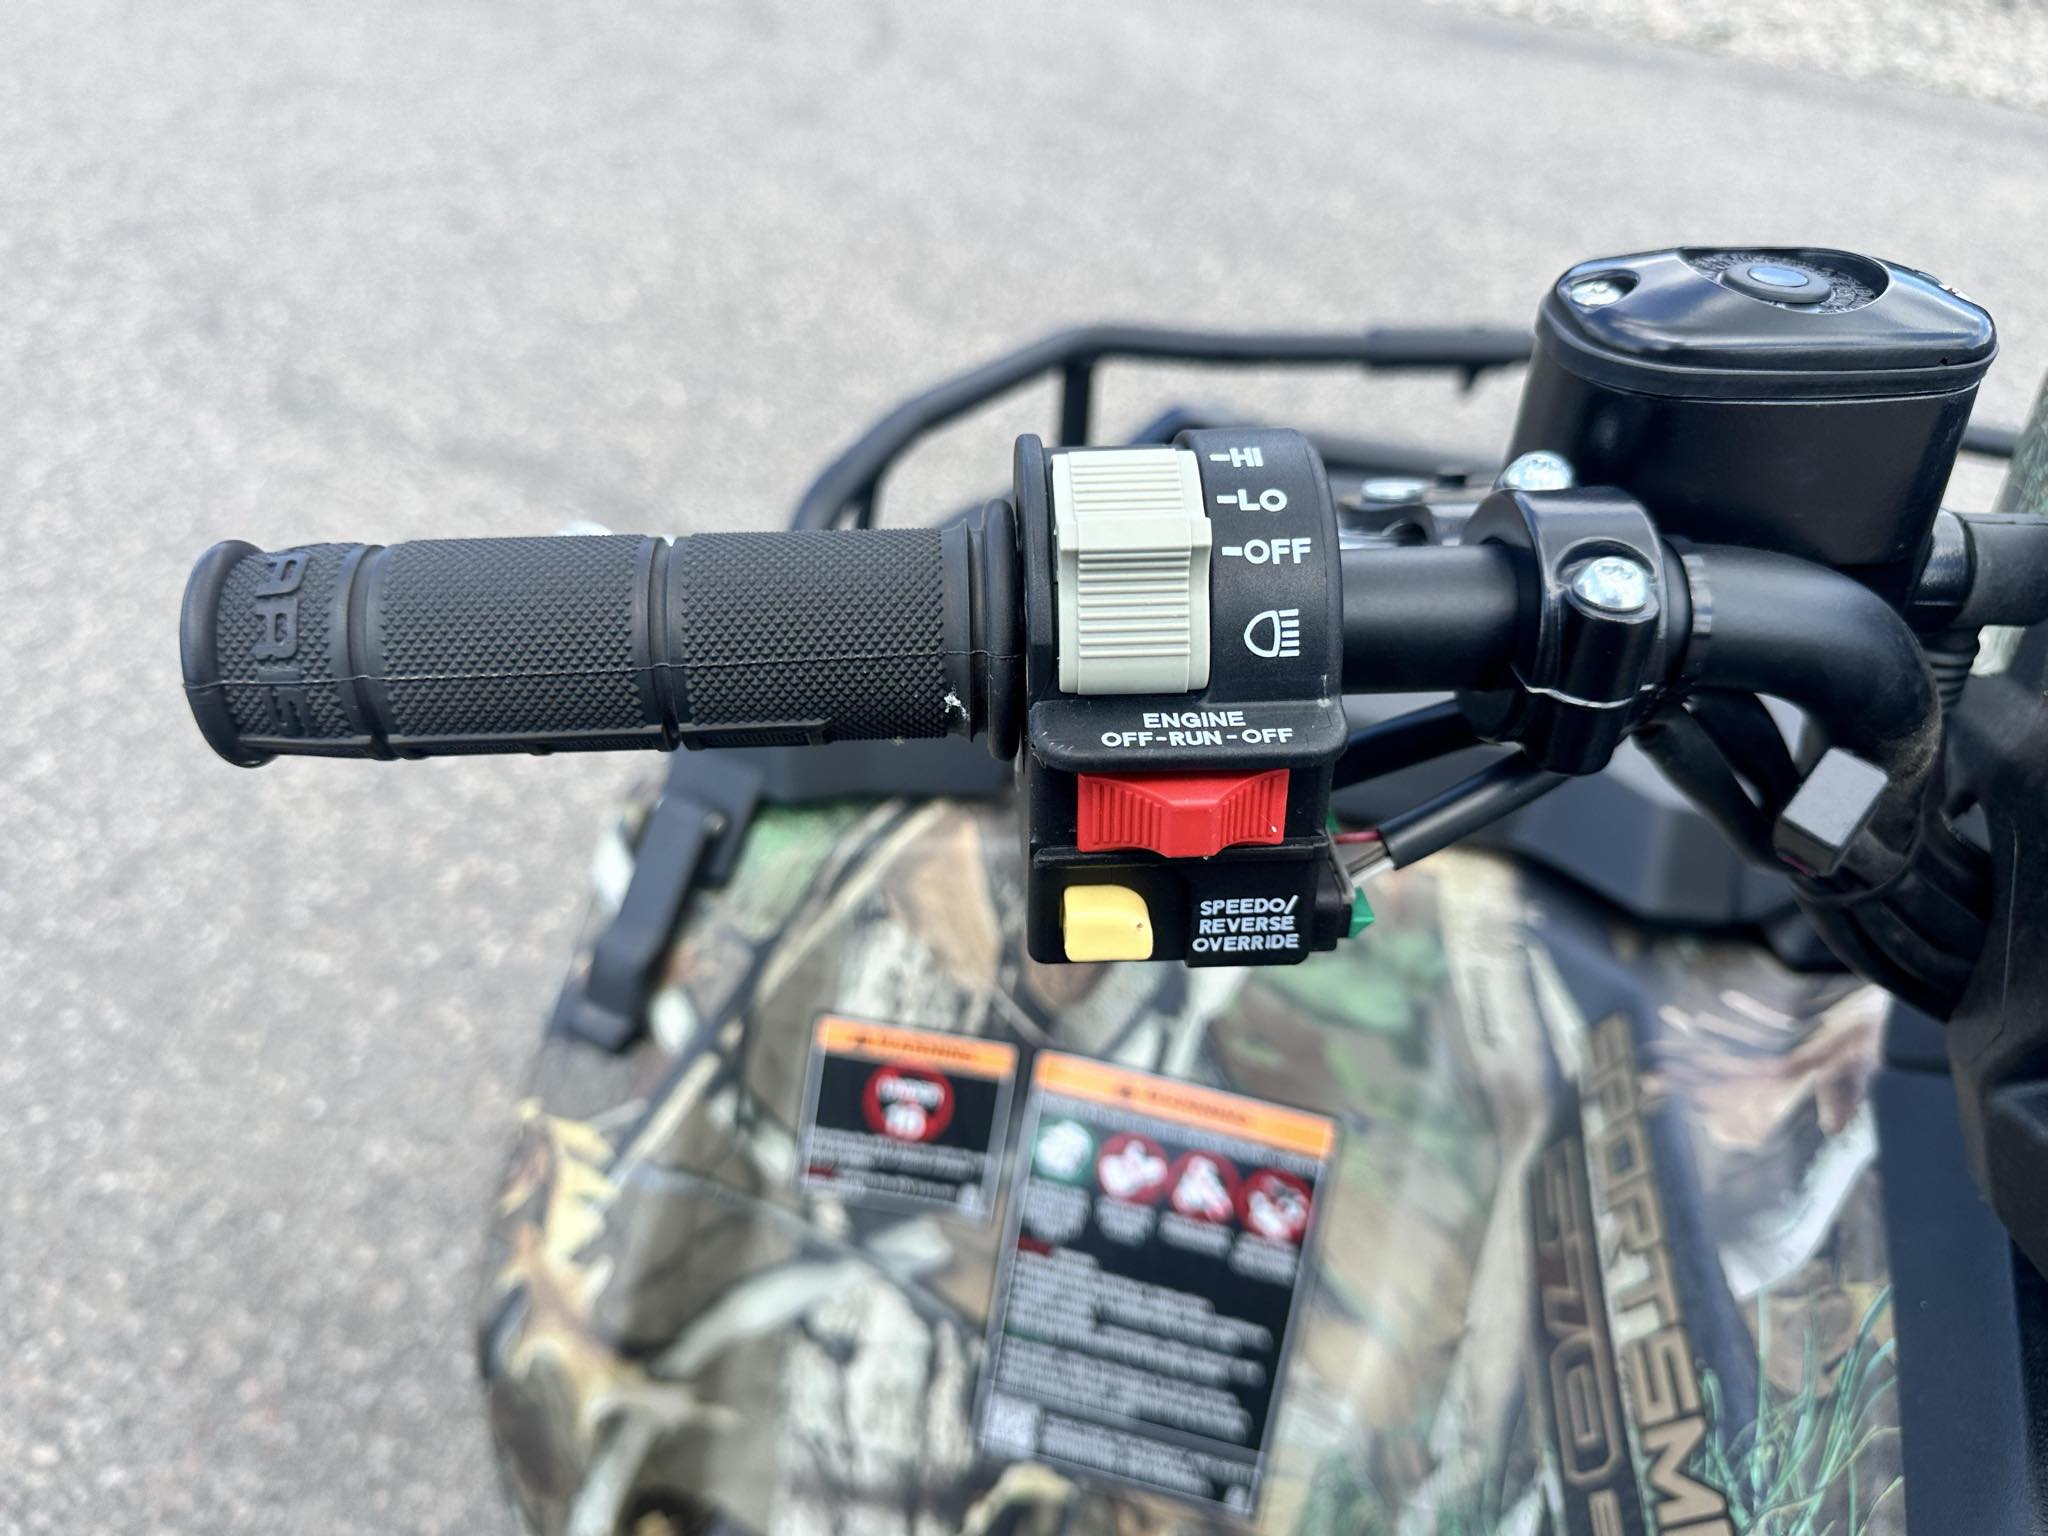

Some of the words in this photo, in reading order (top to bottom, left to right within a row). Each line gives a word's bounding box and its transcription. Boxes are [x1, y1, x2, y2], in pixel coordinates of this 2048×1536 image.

[1142, 710, 1246, 729] ENGINE
[1200, 895, 1299, 917] SPEEDO/
[1199, 915, 1295, 935] REVERSE
[1192, 933, 1300, 953] OVERRIDE
[1586, 1014, 1734, 1536] SPORTSM
